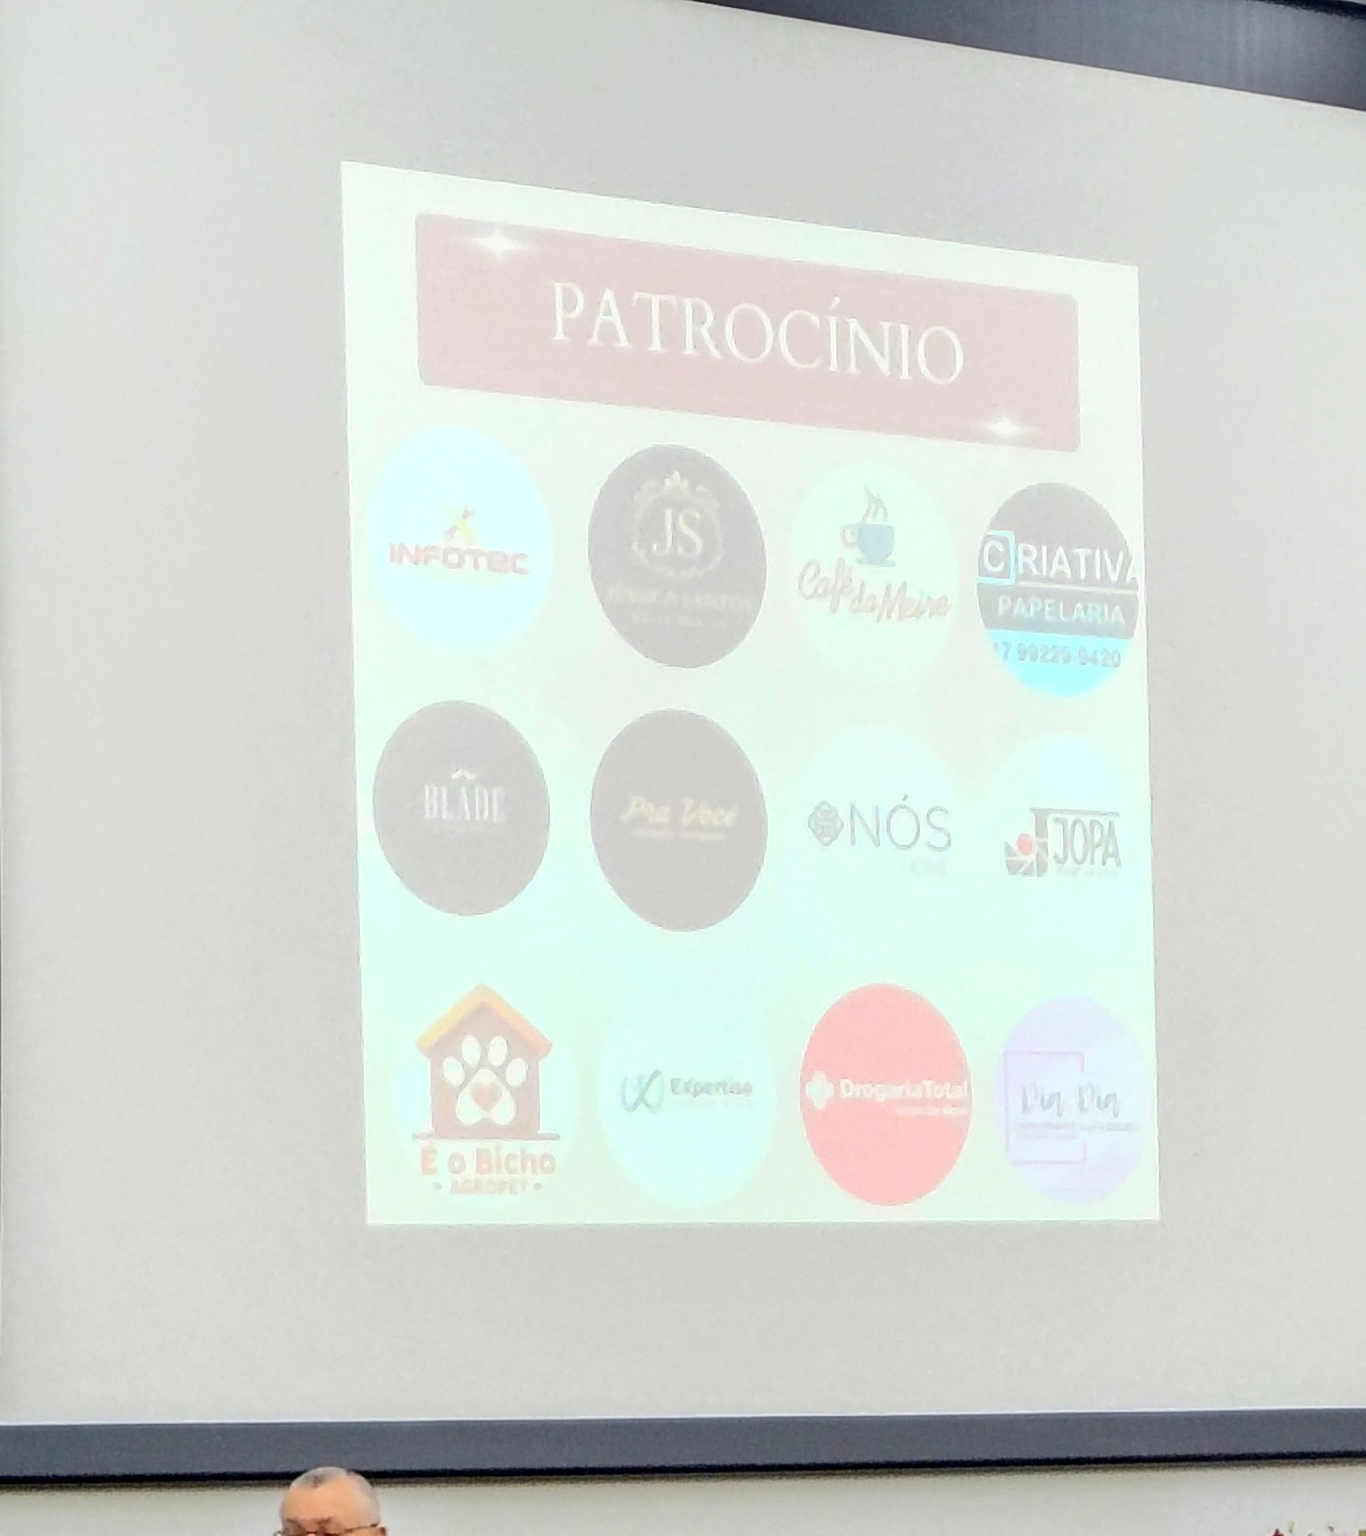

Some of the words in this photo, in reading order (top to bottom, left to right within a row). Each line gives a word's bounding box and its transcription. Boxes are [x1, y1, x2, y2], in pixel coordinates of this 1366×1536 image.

[551, 281, 965, 385] PATROCÍNIO
[651, 507, 705, 561] JS
[997, 594, 1127, 628] PAPELARIA
[849, 794, 953, 851] NÓS
[1053, 816, 1122, 868] JOPA
[476, 1145, 557, 1176] Bicho
